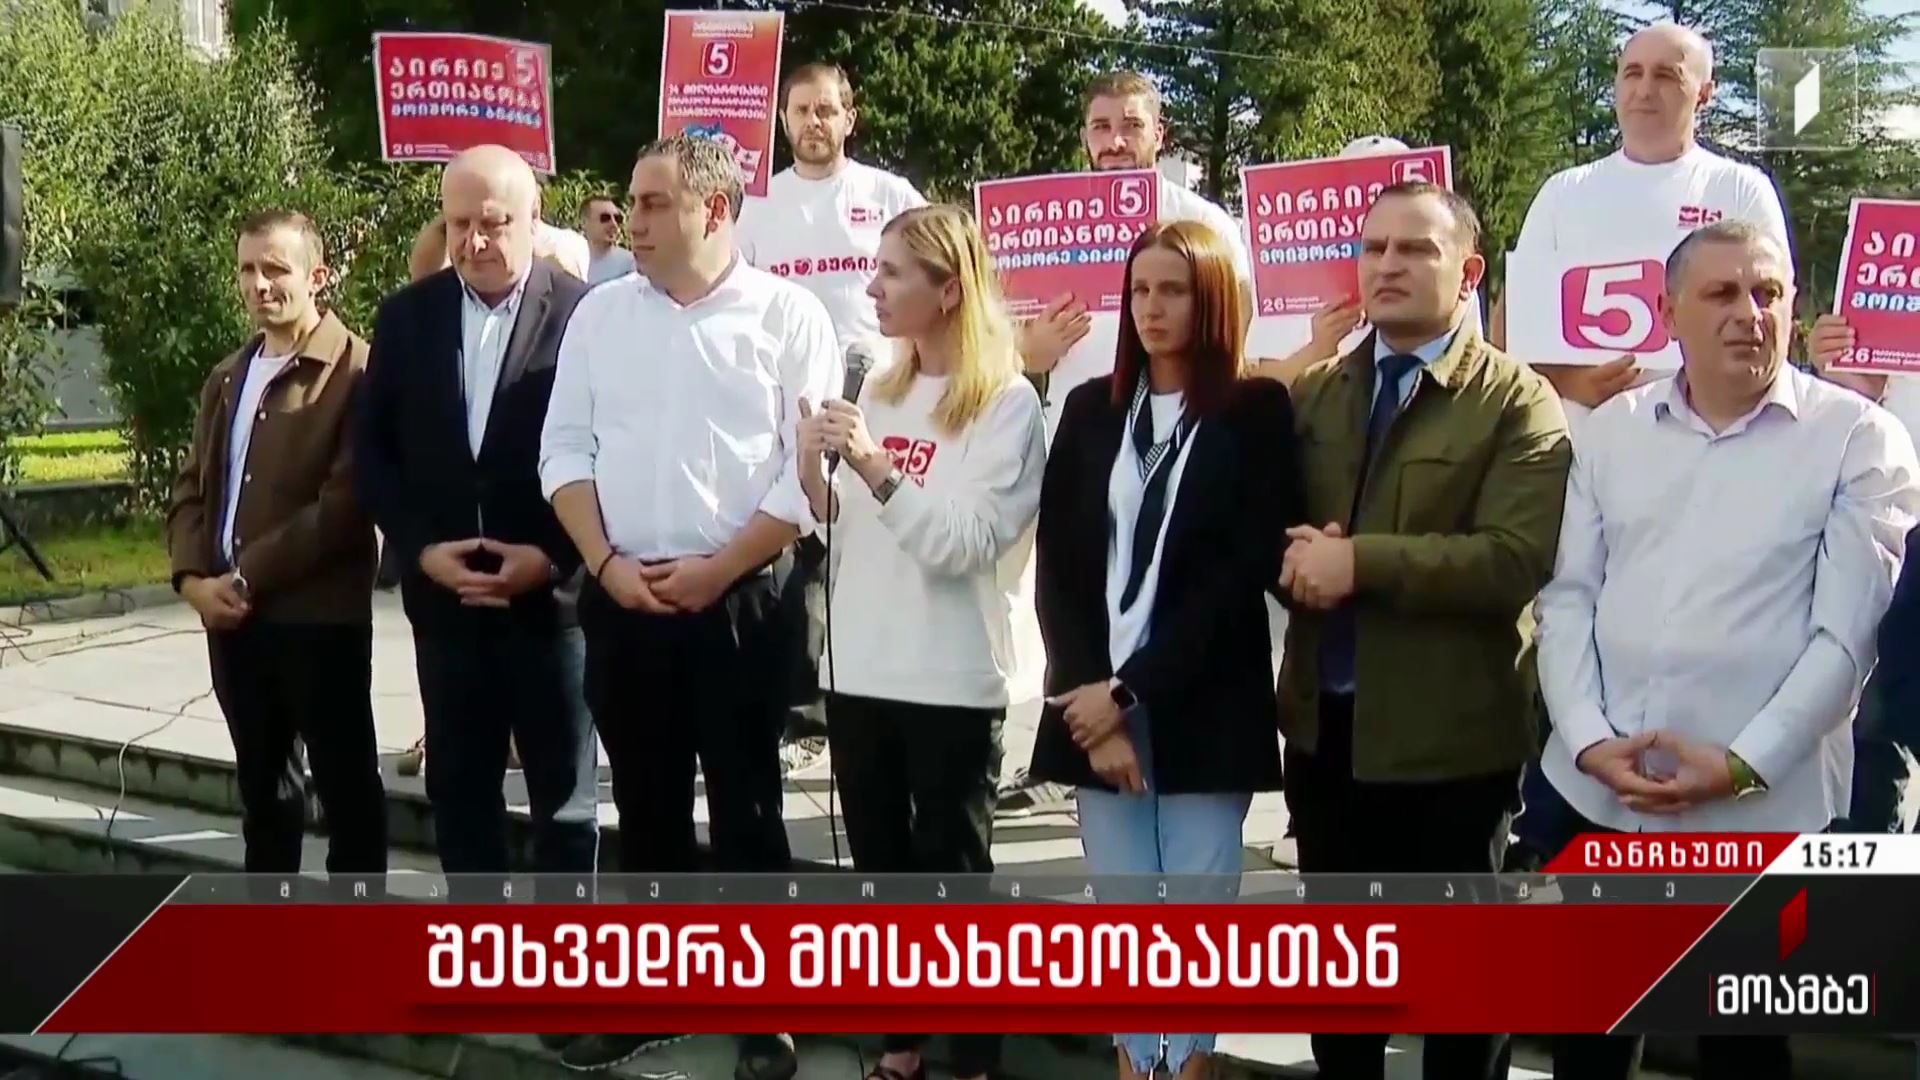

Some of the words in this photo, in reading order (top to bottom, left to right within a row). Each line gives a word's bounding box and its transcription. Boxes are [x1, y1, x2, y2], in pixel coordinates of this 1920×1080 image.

[389, 57, 505, 81] აირჩიე
[514, 50, 538, 87] 5
[707, 43, 730, 75] 5
[391, 102, 480, 118] მოიშორე
[392, 143, 414, 156] 26
[988, 198, 1104, 227] აირჩიე
[1118, 178, 1142, 216] 5
[1256, 182, 1384, 217] აირჩიე
[1078, 247, 1131, 264] ბიძი
[1259, 243, 1353, 265] მოიშორე
[1263, 297, 1285, 313] 26
[1577, 263, 1653, 350] 5
[1840, 347, 1870, 363] 26
[908, 440, 933, 475] 5
